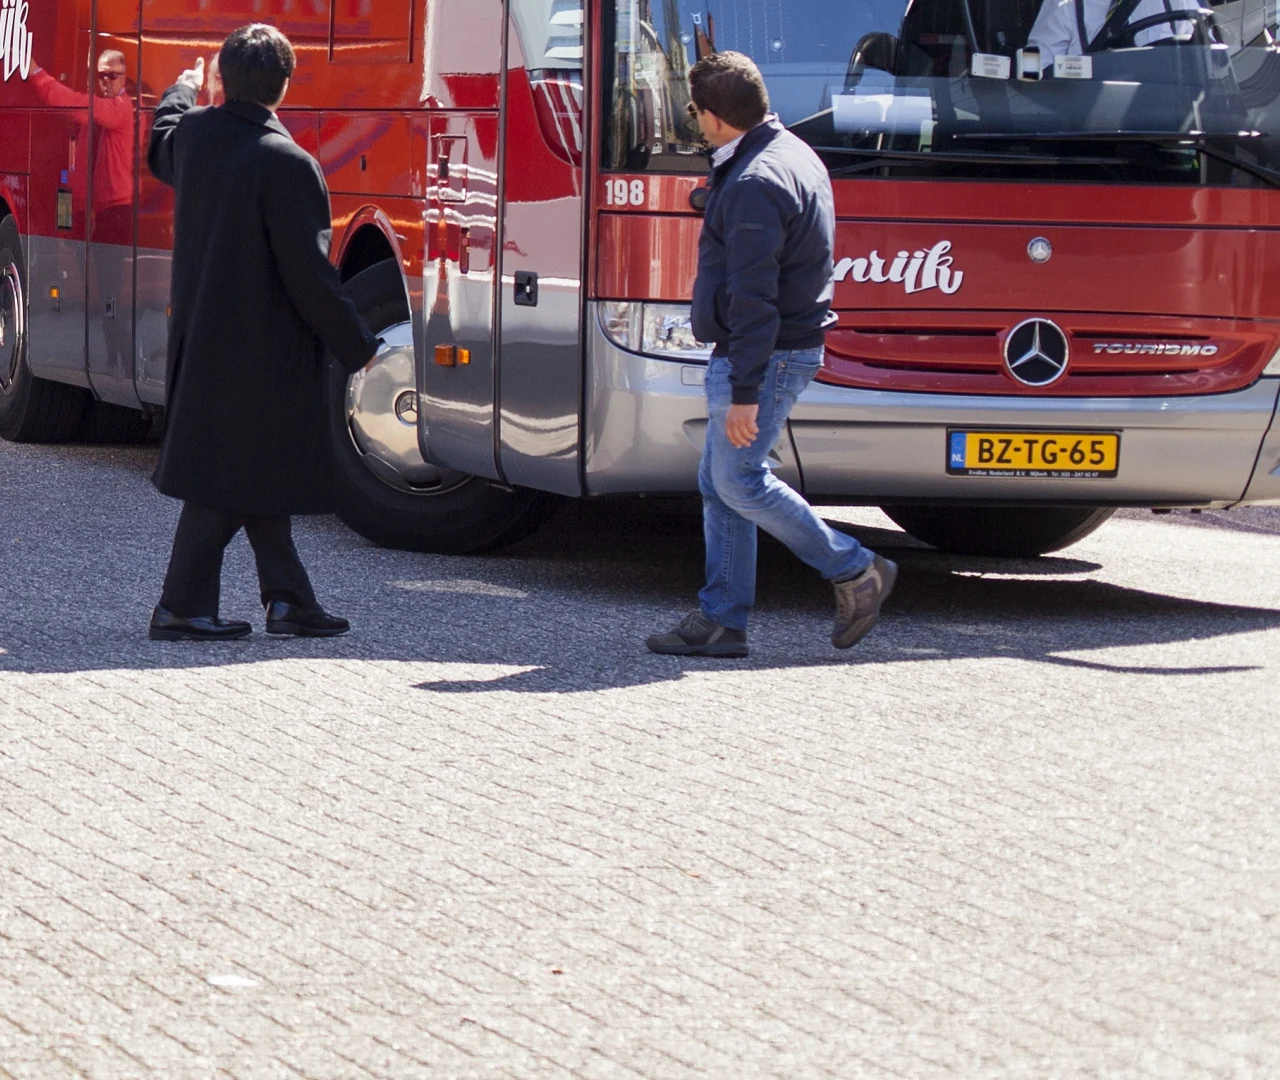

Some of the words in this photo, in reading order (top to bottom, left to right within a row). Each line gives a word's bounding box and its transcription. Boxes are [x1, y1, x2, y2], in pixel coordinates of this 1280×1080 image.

[605, 179, 645, 206] 198
[833, 240, 963, 294] nrijk
[1092, 342, 1218, 356] TOURISMO
[951, 453, 964, 463] NL
[977, 438, 1106, 466] BZ-TG-65
